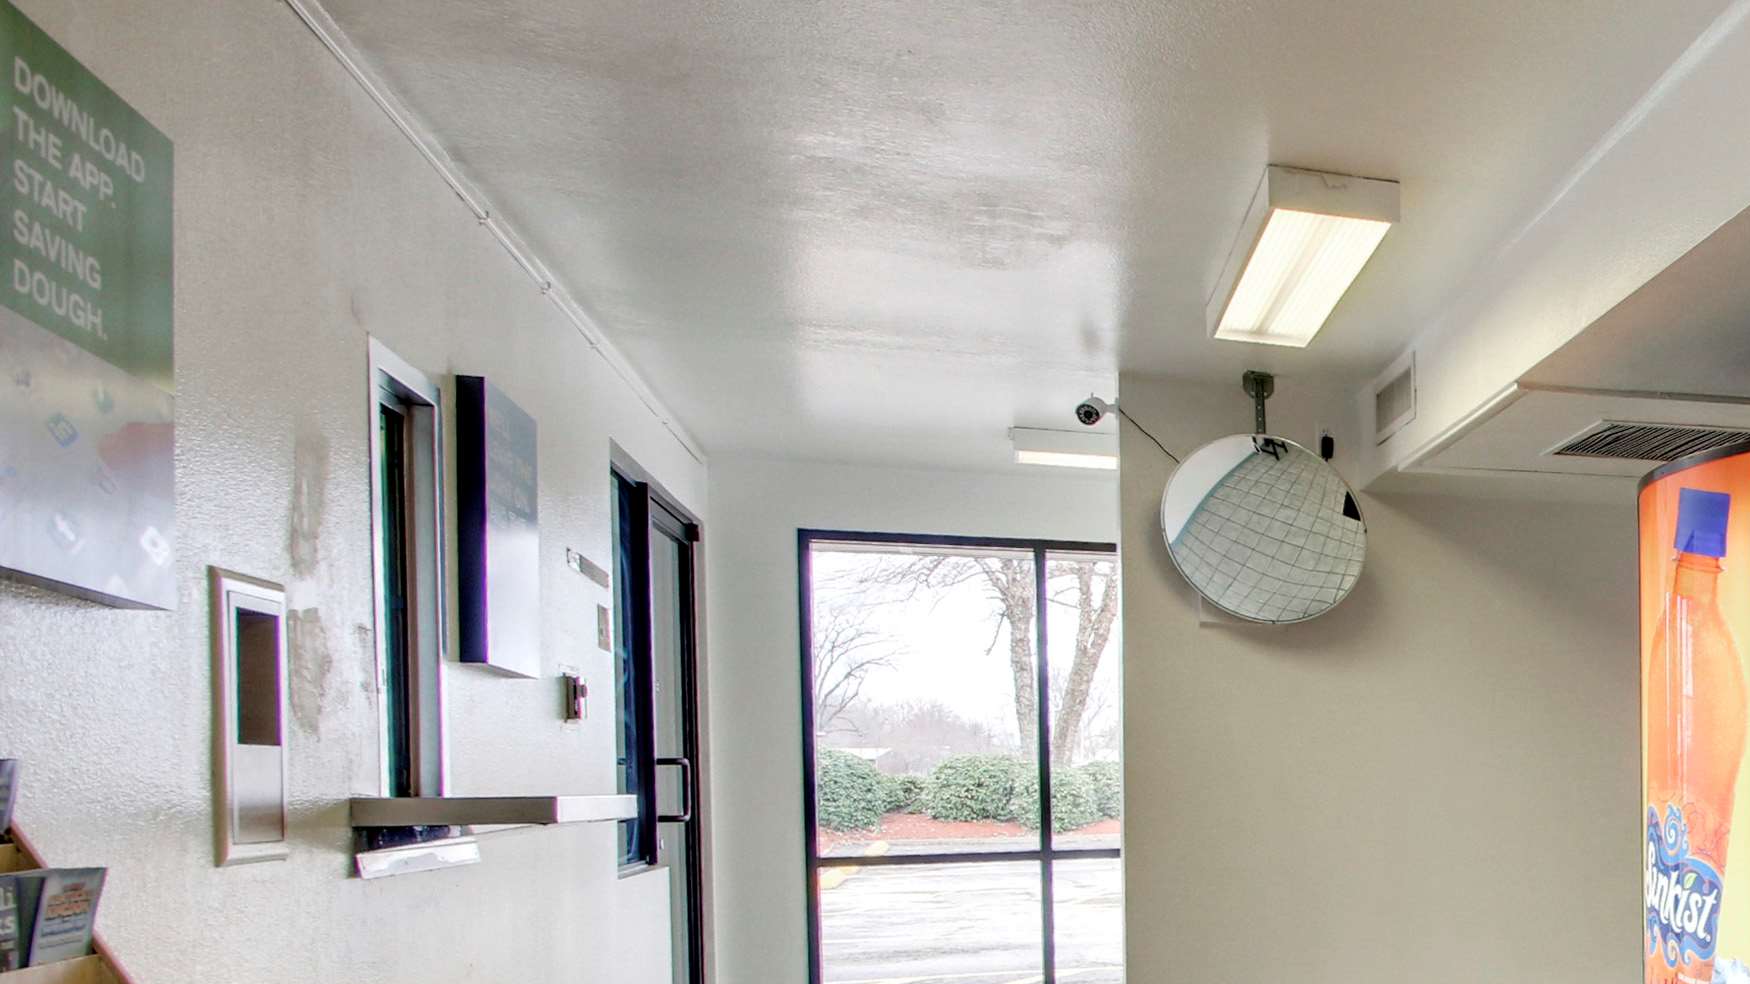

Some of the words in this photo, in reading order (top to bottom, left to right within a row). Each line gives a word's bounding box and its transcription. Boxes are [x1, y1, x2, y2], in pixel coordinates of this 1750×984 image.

[12, 105, 63, 171] THE
[68, 152, 117, 210] APP.
[13, 55, 146, 184] DOWNLOAD
[13, 159, 88, 233] START
[13, 209, 102, 290] SAVING
[13, 258, 109, 341] DOUGH.
[1645, 841, 1718, 941] Sunkist
